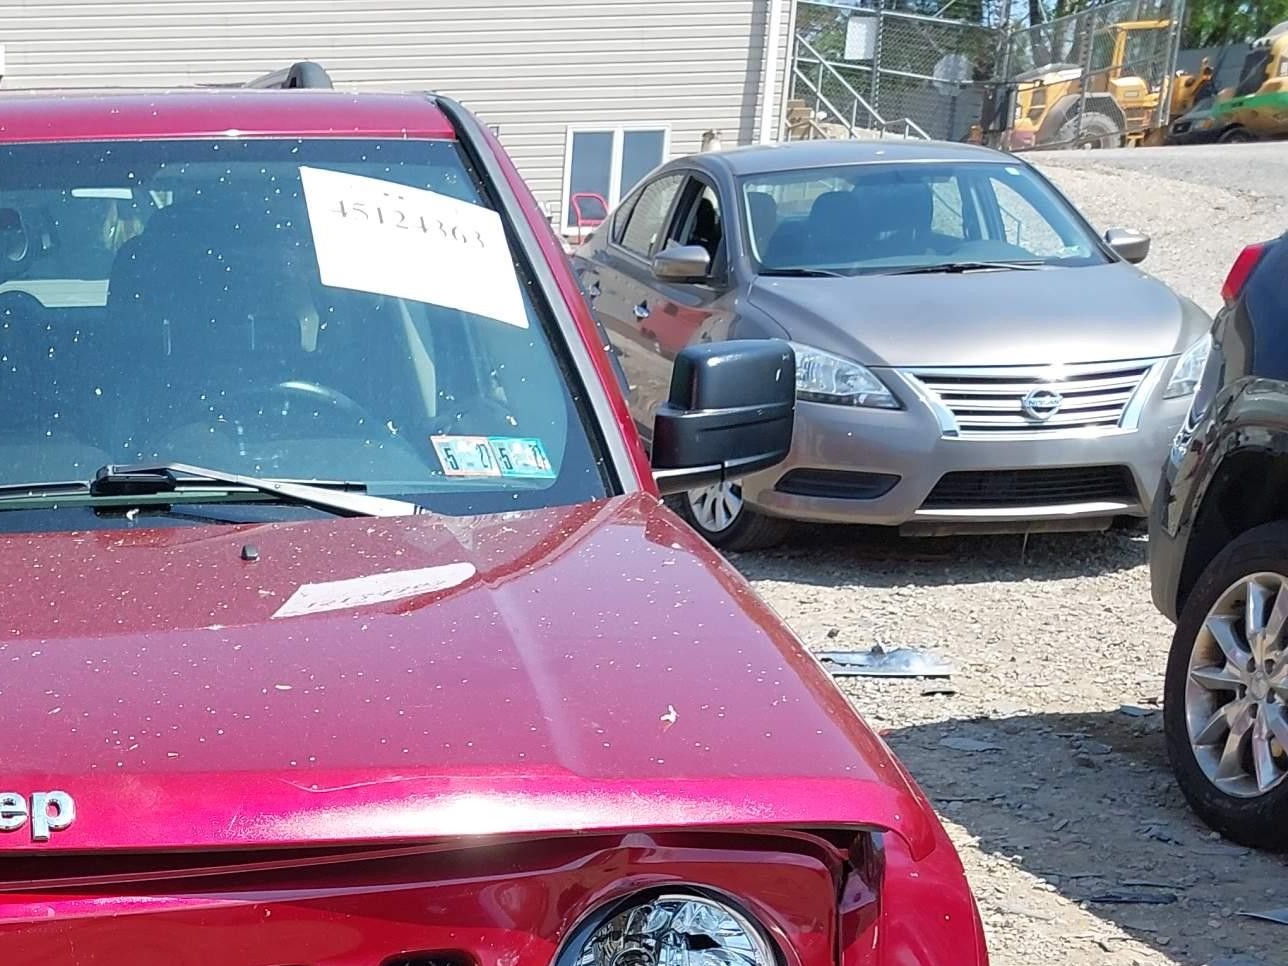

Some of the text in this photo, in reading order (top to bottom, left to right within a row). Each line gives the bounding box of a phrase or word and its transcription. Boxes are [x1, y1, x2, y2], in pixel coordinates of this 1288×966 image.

[330, 199, 486, 249] 45124363
[443, 447, 460, 471] 5
[498, 447, 514, 471] 5
